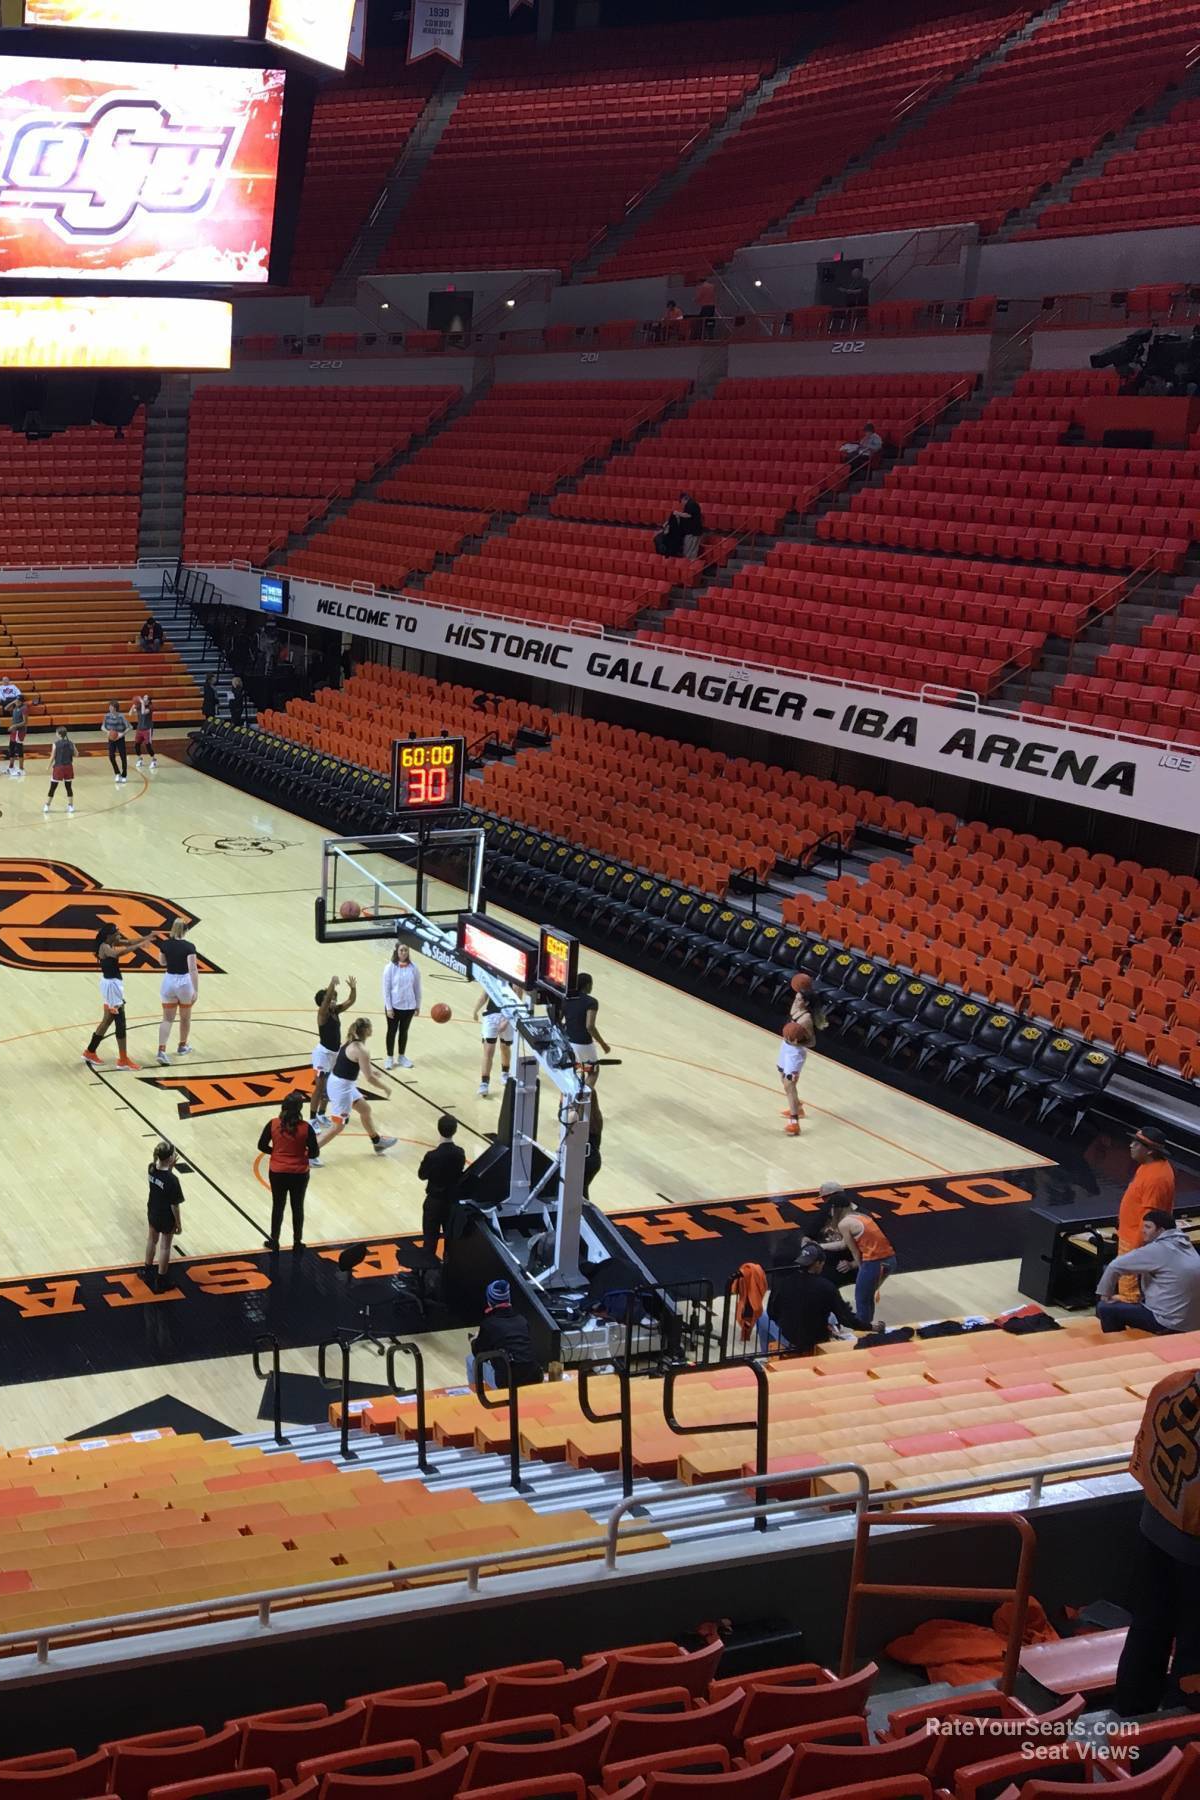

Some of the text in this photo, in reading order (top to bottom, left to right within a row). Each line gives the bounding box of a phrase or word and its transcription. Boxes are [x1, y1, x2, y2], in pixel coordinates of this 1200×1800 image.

[831, 341, 865, 353] 202
[310, 360, 343, 369] 220
[581, 352, 599, 362] 201
[316, 598, 391, 627] WELCOME
[395, 614, 417, 633] TO
[445, 623, 574, 670] HISTORIC
[938, 728, 1137, 797] ARENA
[402, 745, 454, 767] 60:00
[1158, 755, 1196, 772] 103
[408, 768, 446, 803] 30
